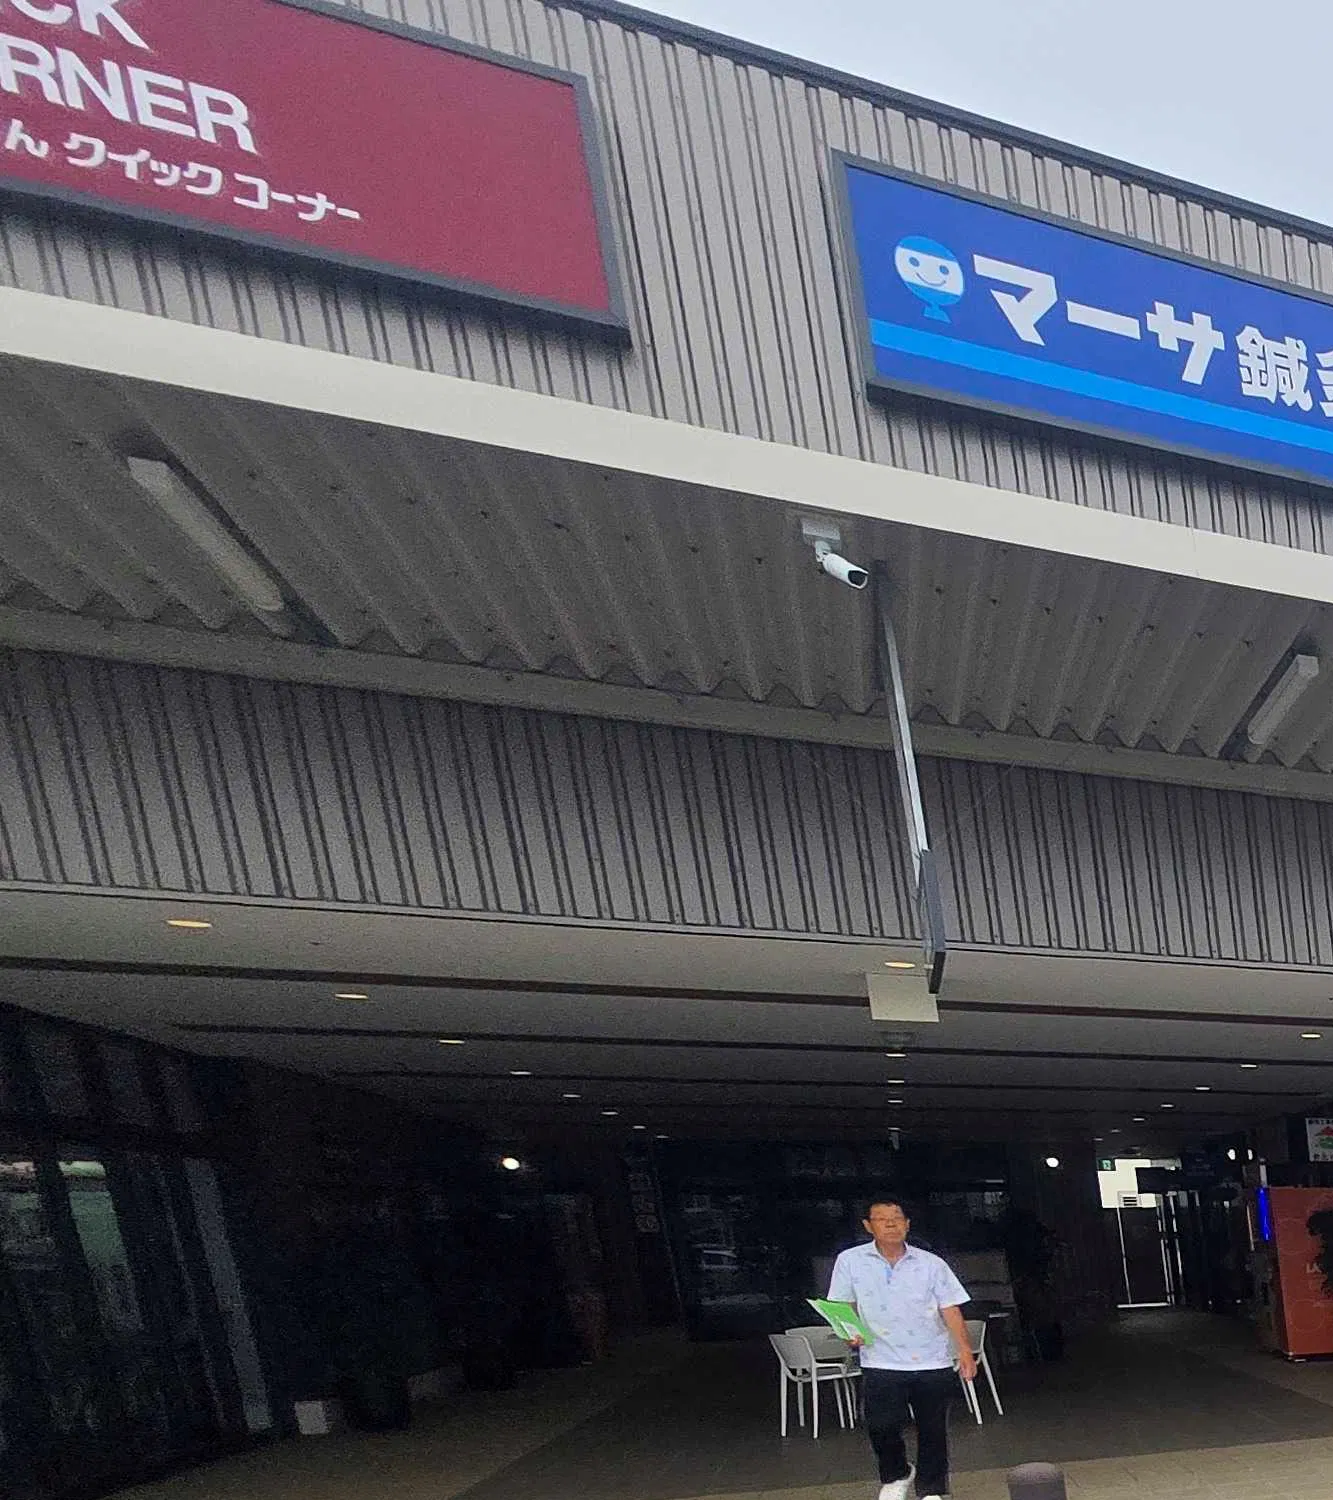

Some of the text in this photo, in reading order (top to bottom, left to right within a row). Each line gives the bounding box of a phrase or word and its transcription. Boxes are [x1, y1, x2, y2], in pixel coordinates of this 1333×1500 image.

[64, 132, 224, 196] クイック
[233, 172, 361, 222] コーナー
